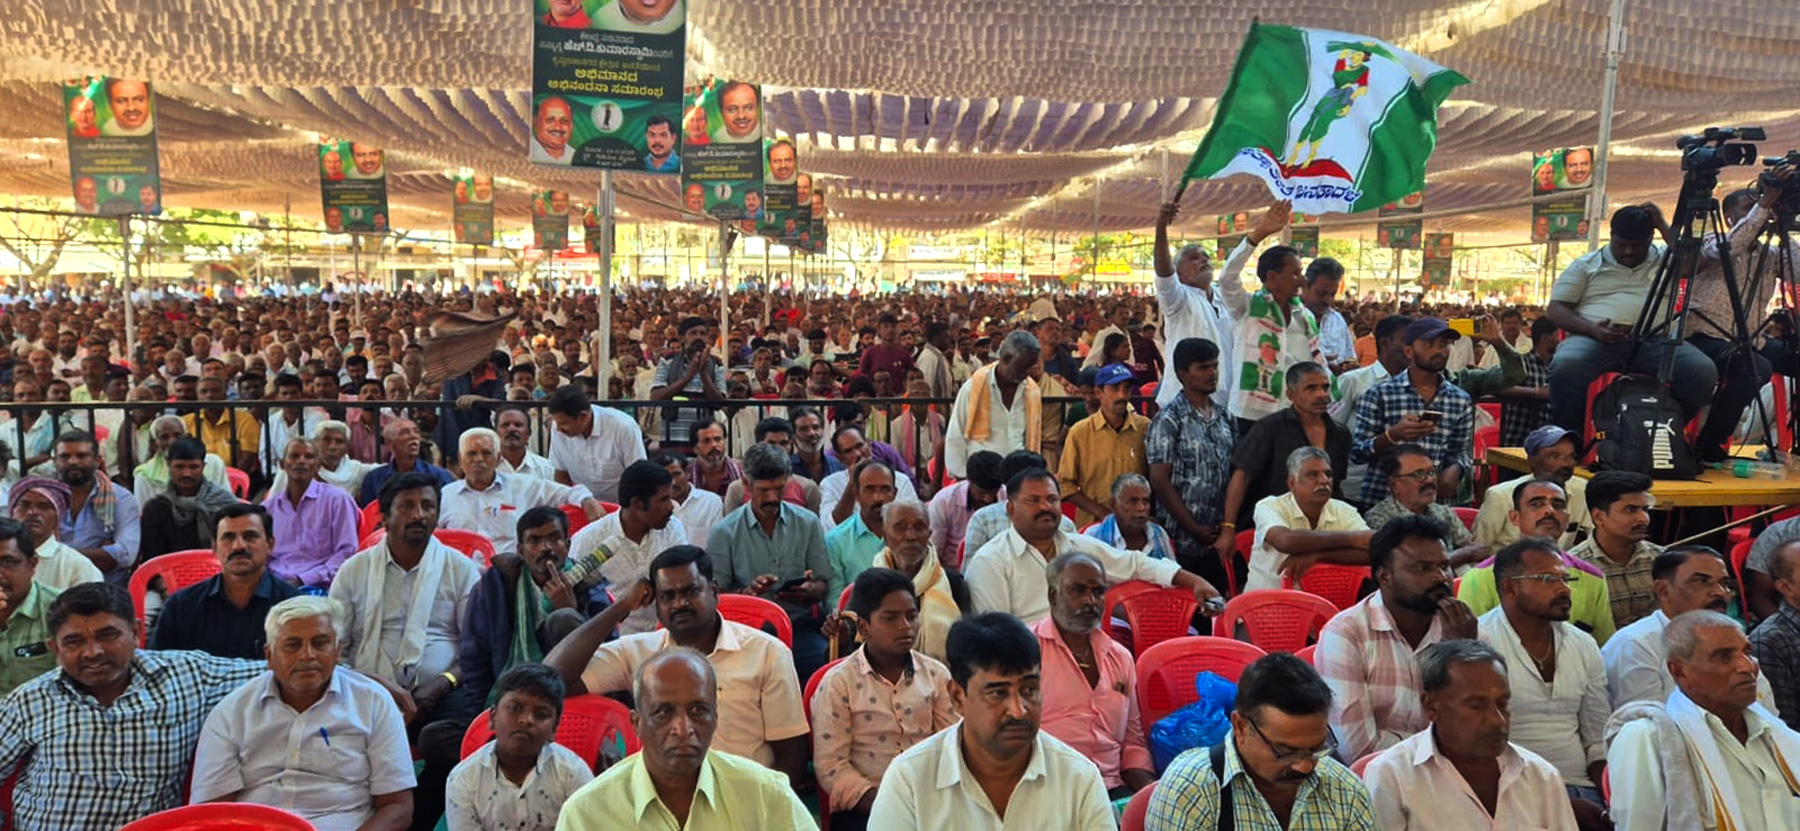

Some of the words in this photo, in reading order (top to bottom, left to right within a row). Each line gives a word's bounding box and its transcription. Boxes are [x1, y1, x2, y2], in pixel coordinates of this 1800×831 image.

[575, 68, 638, 82] ಅಭಿಮಾನದ
[547, 79, 609, 92] ಅಭಿನಂದನಾ
[611, 84, 664, 99] ಸಮಾರಂಭ
